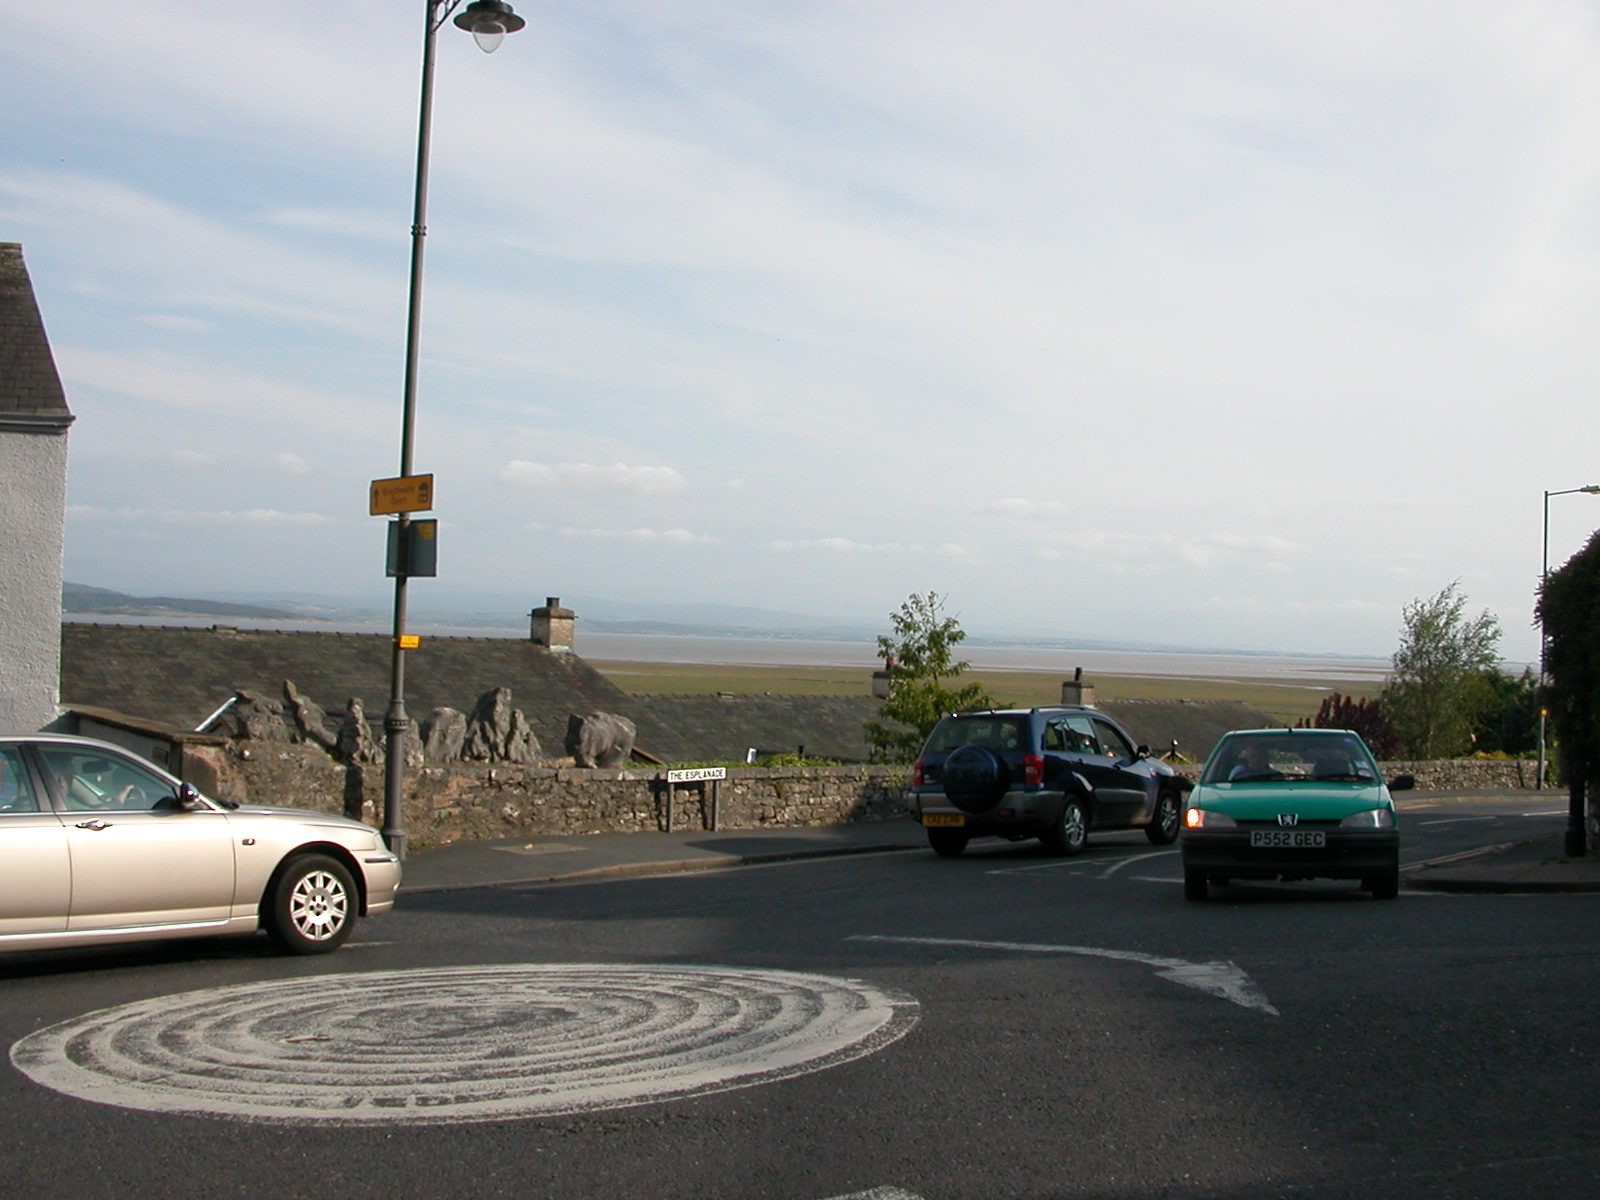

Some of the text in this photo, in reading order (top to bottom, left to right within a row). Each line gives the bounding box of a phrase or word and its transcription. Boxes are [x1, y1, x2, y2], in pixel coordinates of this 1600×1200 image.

[670, 769, 724, 780] THE ESPLANADE
[1253, 832, 1323, 846] P552 GEC
